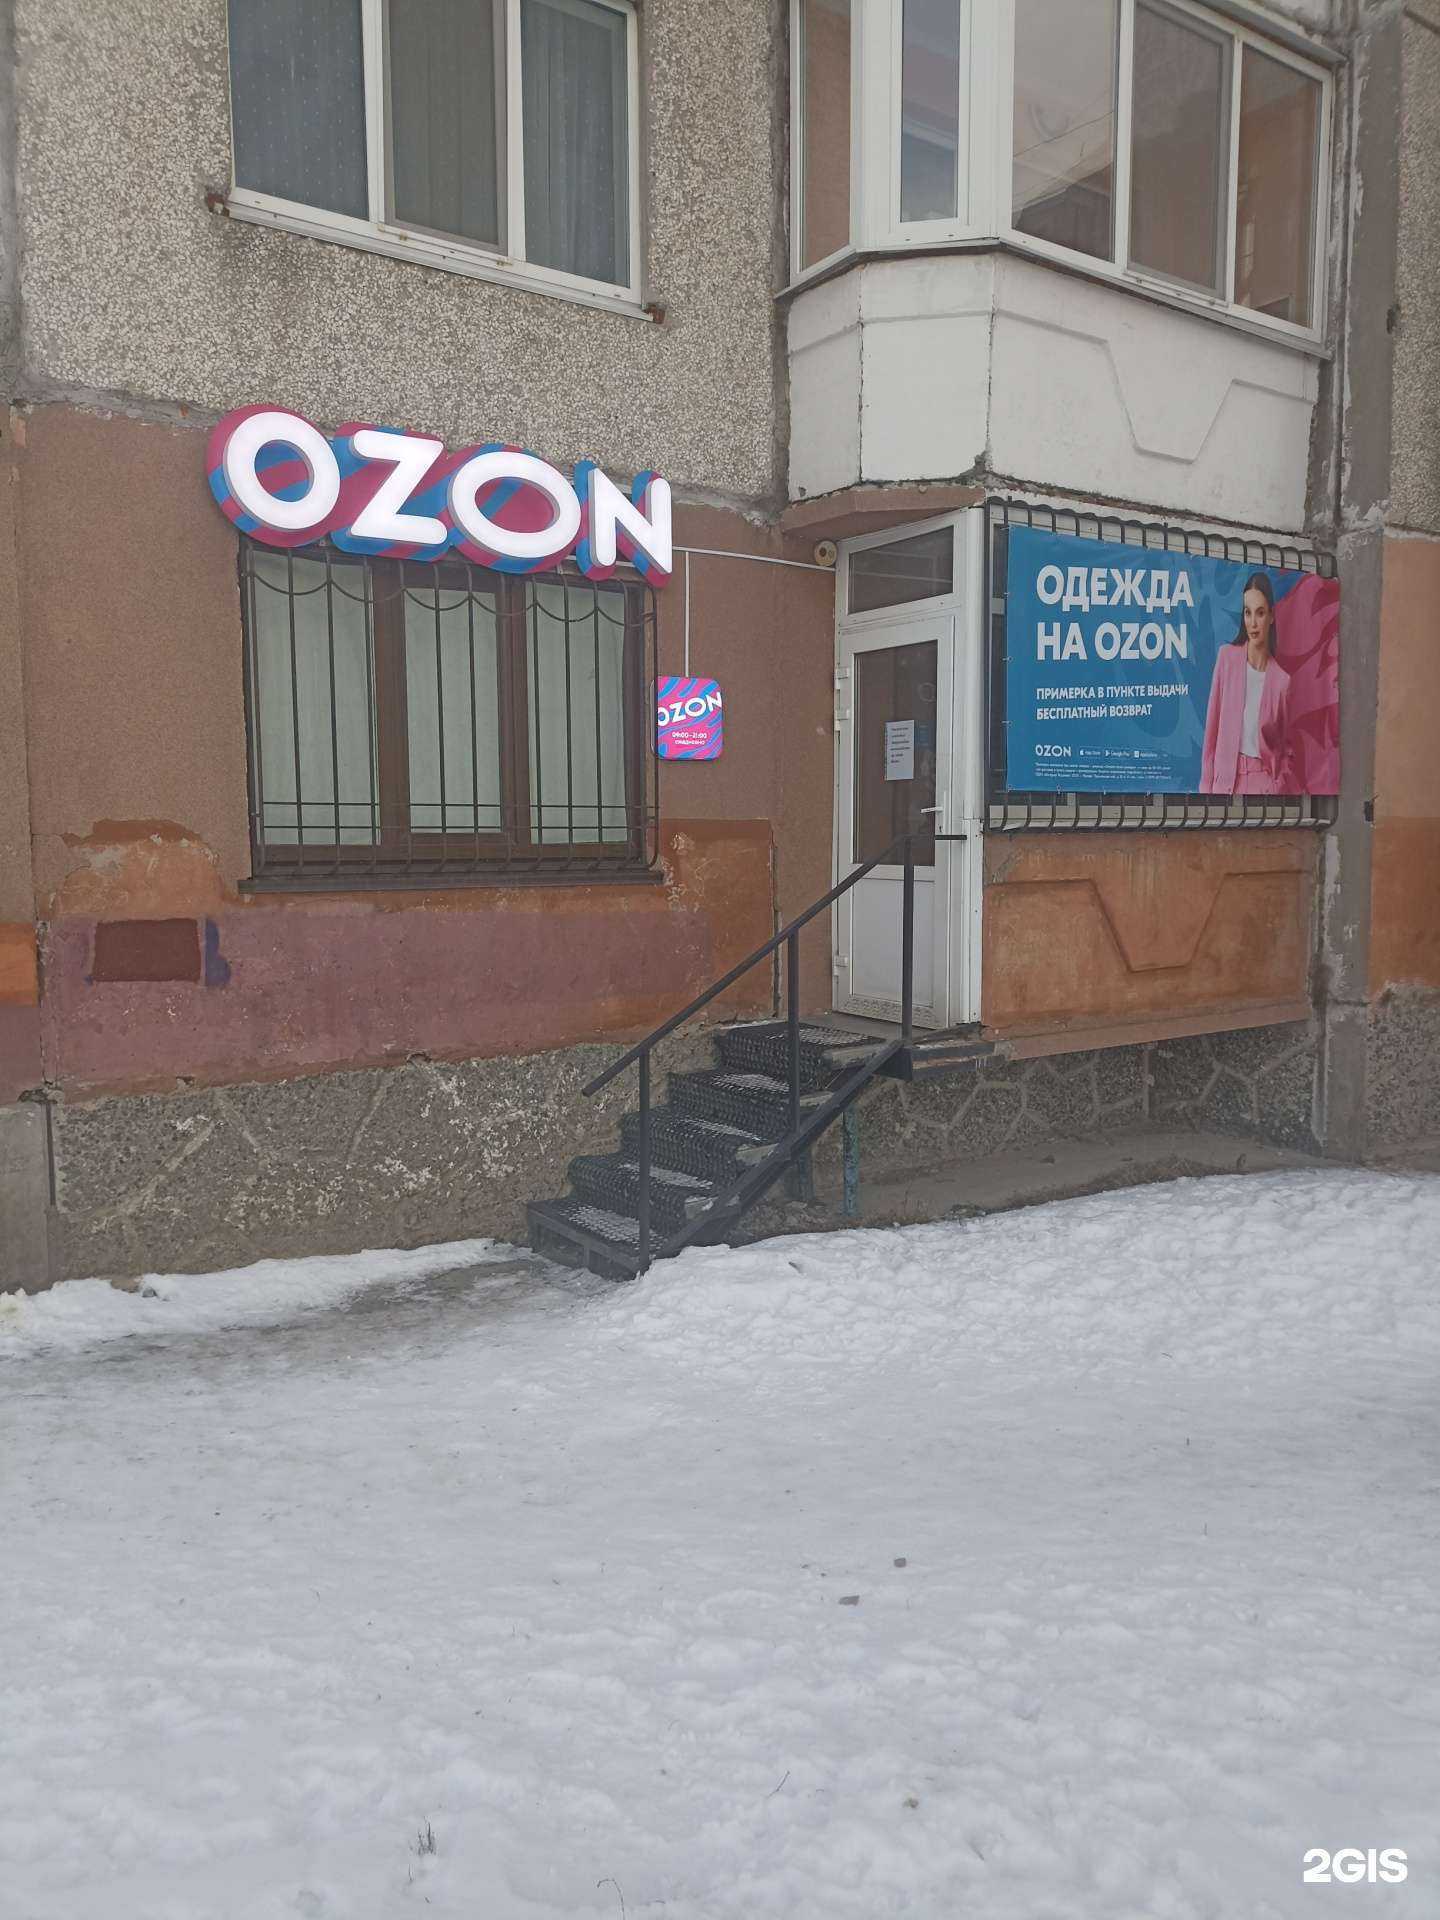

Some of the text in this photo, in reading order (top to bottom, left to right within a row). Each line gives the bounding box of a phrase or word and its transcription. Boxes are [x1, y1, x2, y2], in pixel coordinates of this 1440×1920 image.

[225, 410, 674, 575] OZON
[1037, 565, 1194, 613] ОДЕЖДА
[1037, 622, 1188, 661] НА OZON
[657, 691, 722, 727] OZON
[1036, 684, 1189, 700] ПРИМЕРКА В ПУНКТЕ ВЫДАЧИ
[1036, 704, 1152, 720] БЕСПЛАТНЫЙ ВОЗВРАТ
[1035, 744, 1072, 757] OZON
